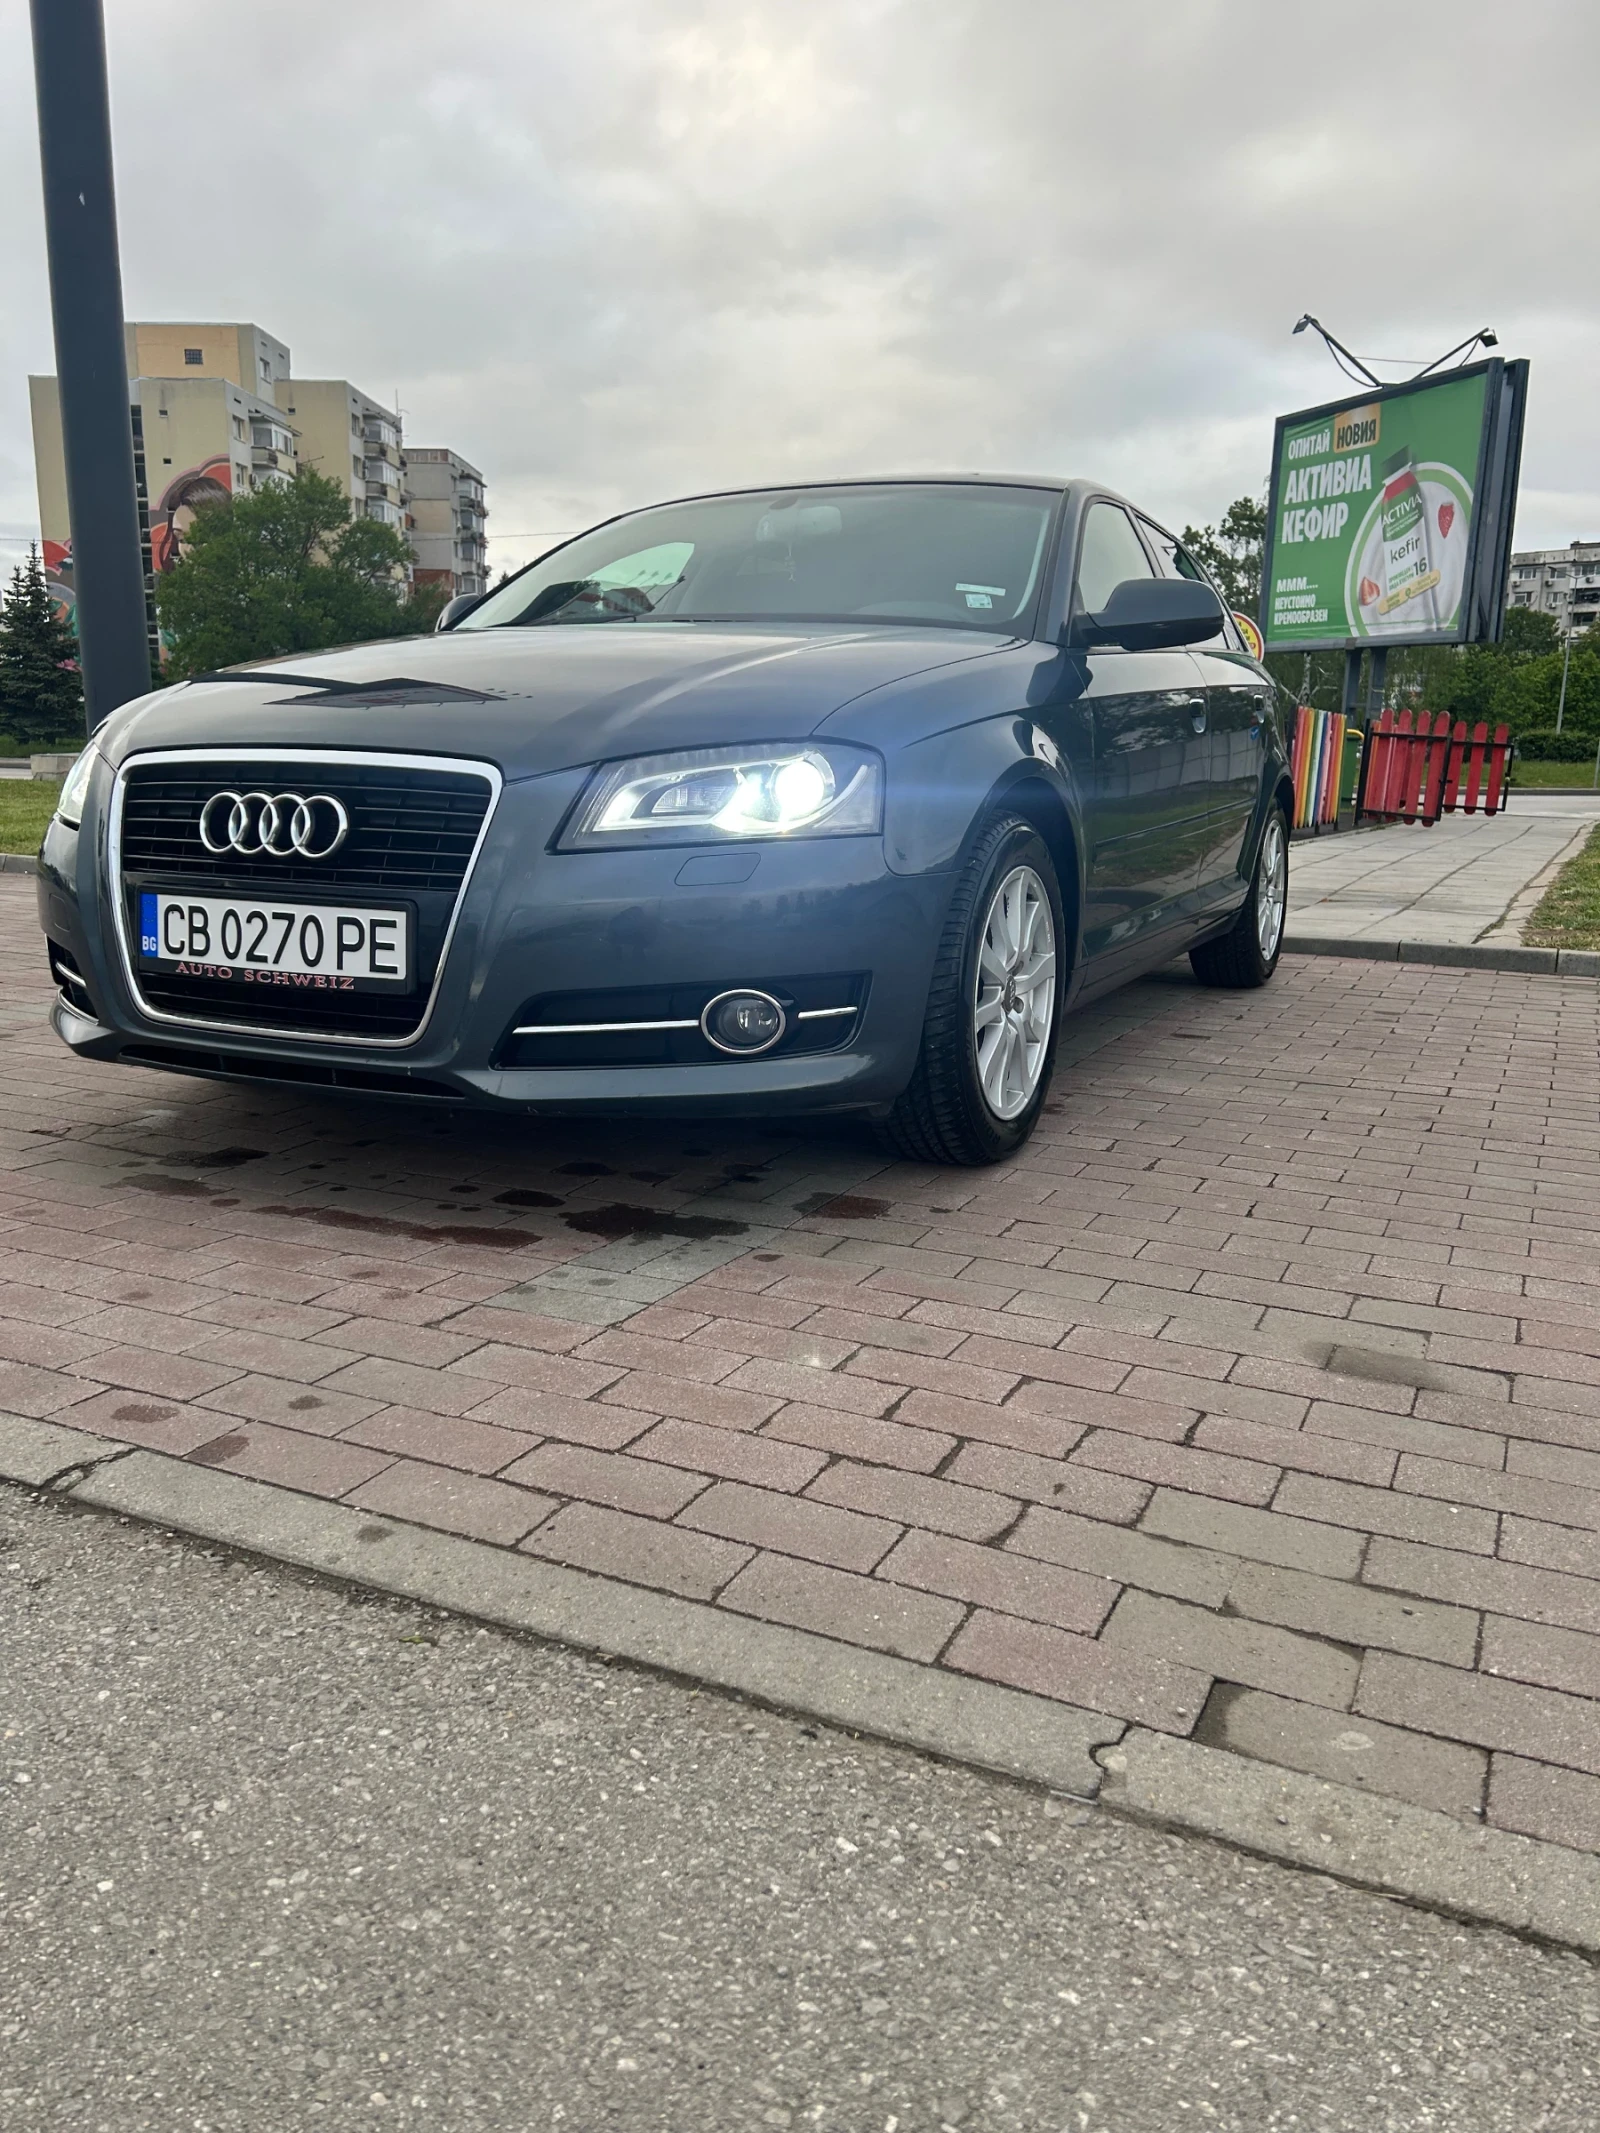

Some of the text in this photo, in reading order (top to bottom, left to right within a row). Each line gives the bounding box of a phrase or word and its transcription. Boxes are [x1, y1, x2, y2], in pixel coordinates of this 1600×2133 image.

[1288, 419, 1377, 460] ОПИТАЙ НОВИЯ
[1284, 454, 1372, 505] АКТИВИА
[1281, 502, 1349, 544] КЕФИР
[1382, 493, 1422, 526] ACTIVIA
[1390, 537, 1420, 564] kefir
[1413, 557, 1427, 576] 16
[141, 935, 157, 951] BG
[163, 903, 398, 974] CB 0270 PE
[175, 962, 354, 990] AUTO SCHWEIZ
